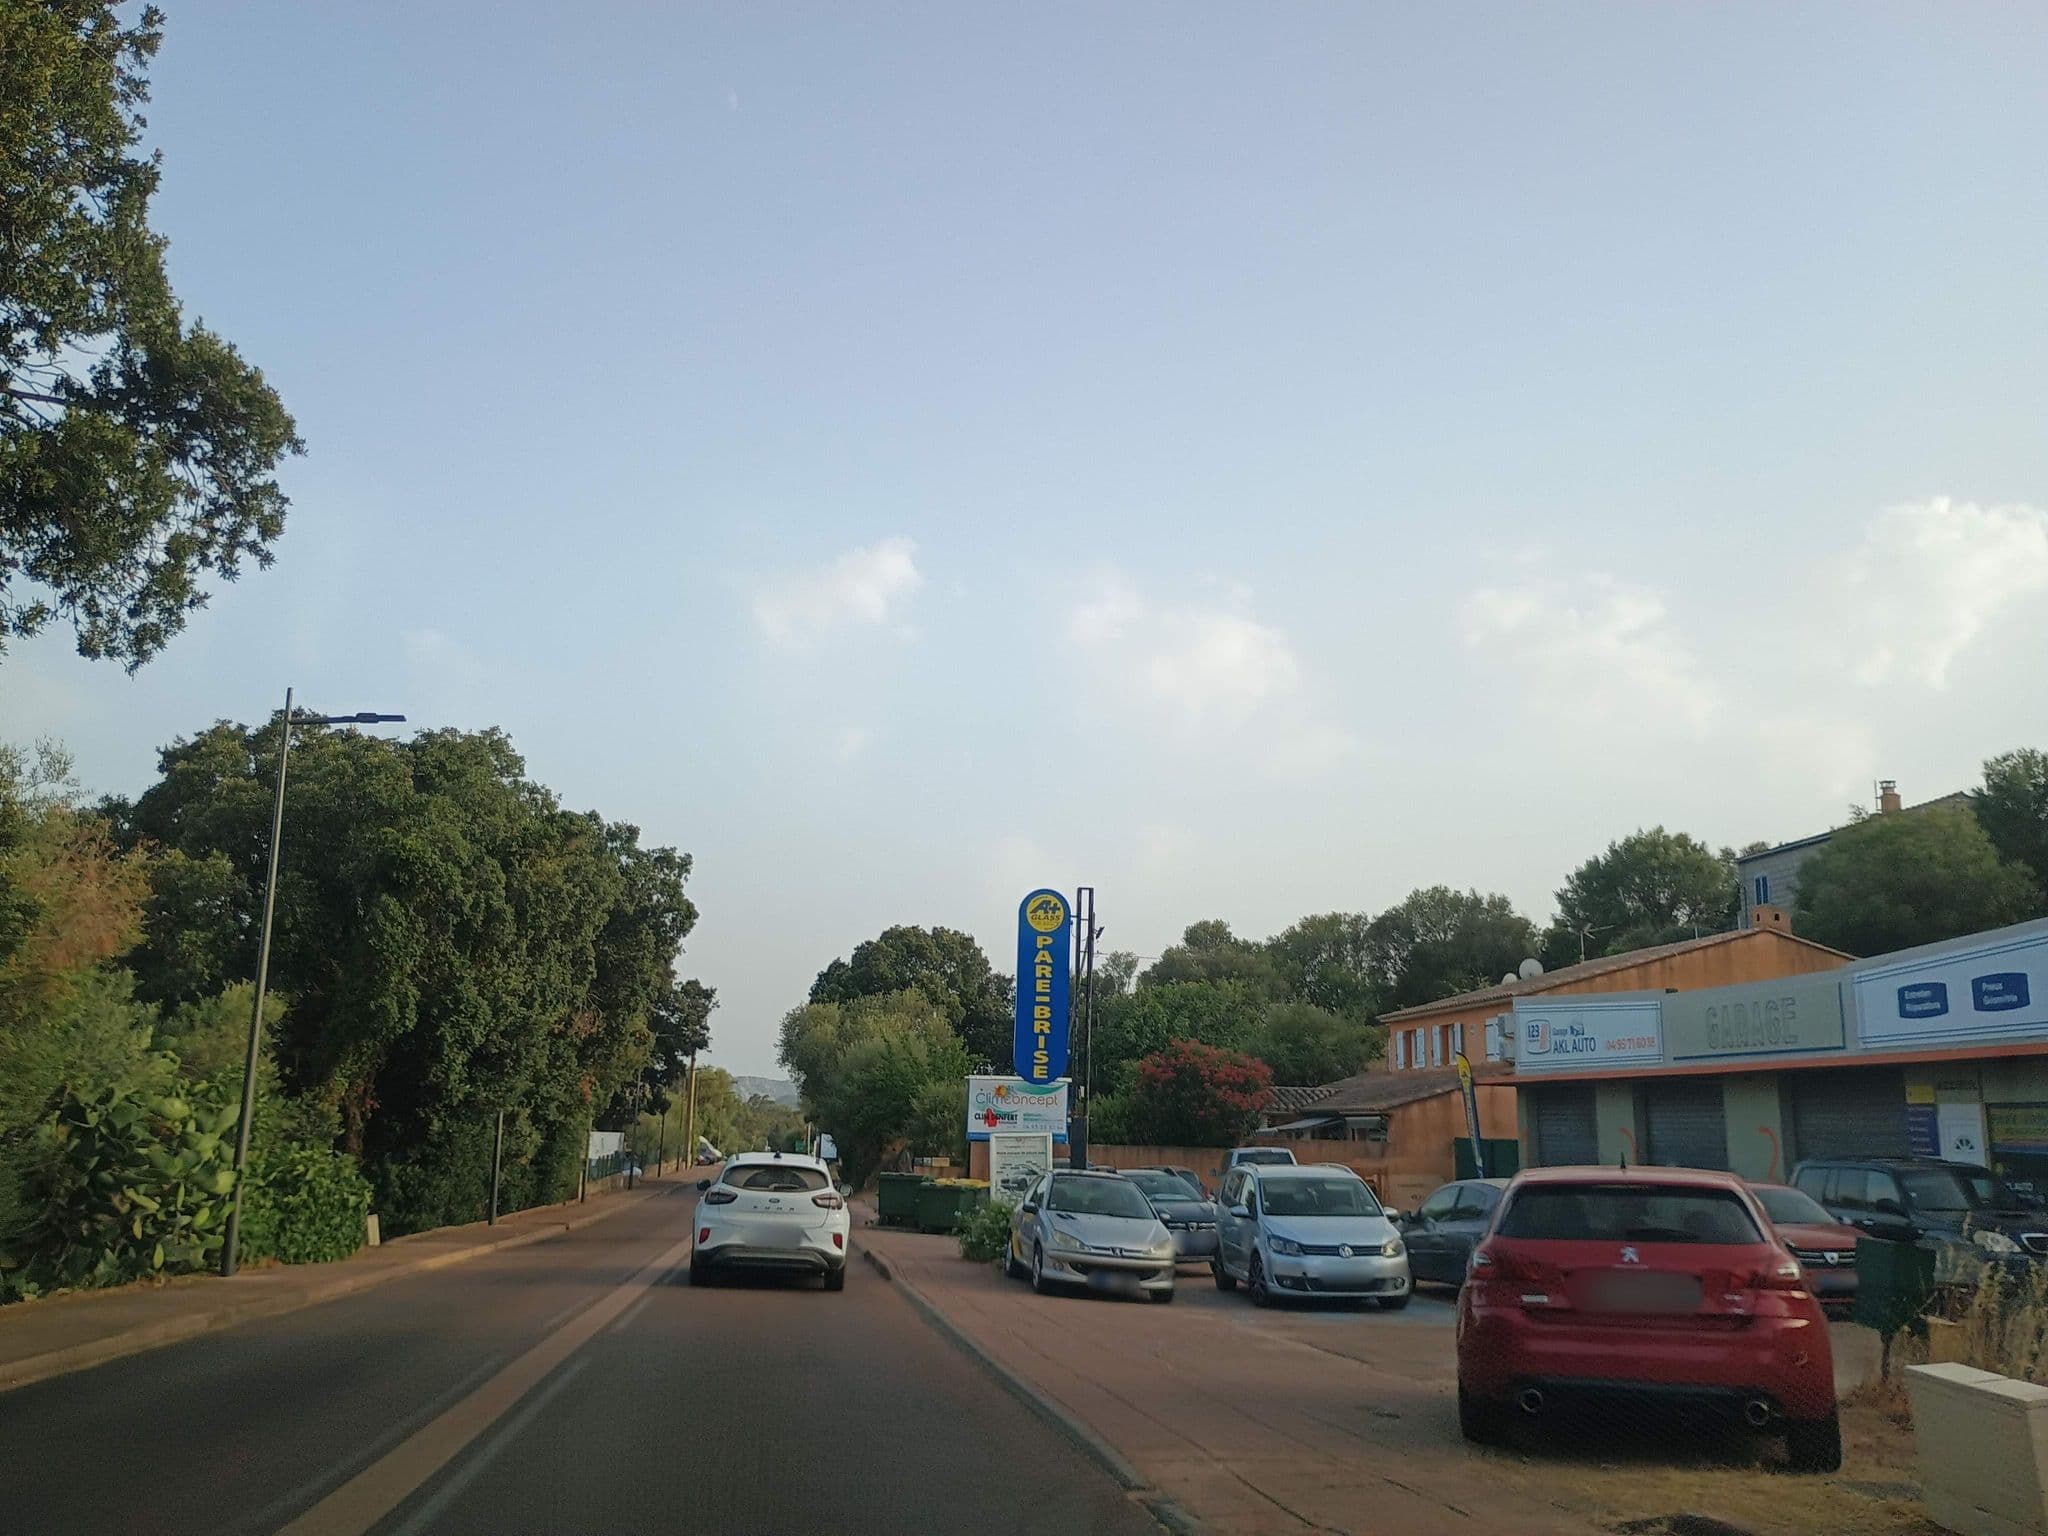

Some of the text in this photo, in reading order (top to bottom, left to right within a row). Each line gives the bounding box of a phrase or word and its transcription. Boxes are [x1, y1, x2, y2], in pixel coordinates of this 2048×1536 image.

[1033, 935, 1054, 1079] PARE-BRISE
[1706, 996, 1799, 1050] GARAGE
[1527, 1024, 1540, 1039] 123
[1553, 1037, 1597, 1054] AKL AUTO
